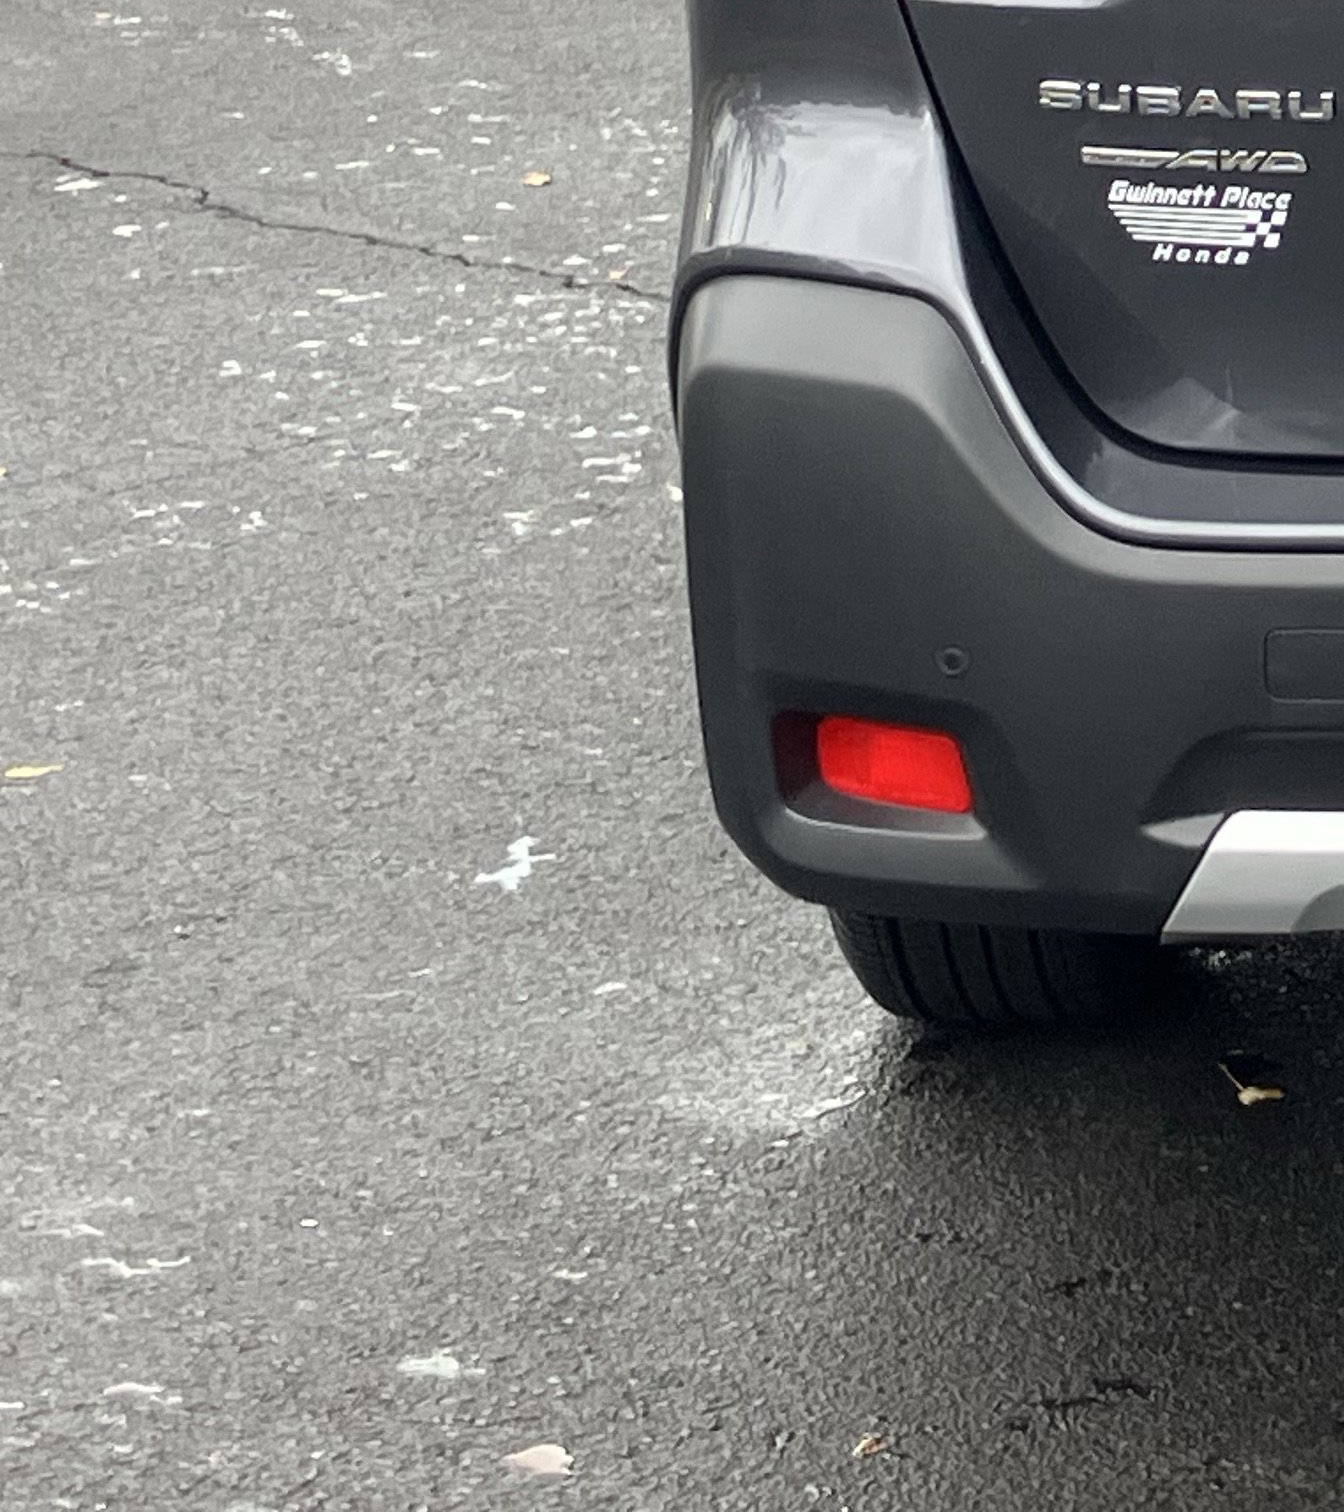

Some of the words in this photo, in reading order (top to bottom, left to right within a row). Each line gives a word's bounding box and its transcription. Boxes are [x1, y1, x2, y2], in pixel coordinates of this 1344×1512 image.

[1039, 79, 1335, 121] SUBARU
[1164, 148, 1308, 174] AWD
[1108, 179, 1216, 207] Gwinnett
[1221, 186, 1293, 210] Place
[1152, 243, 1250, 265] Honda
